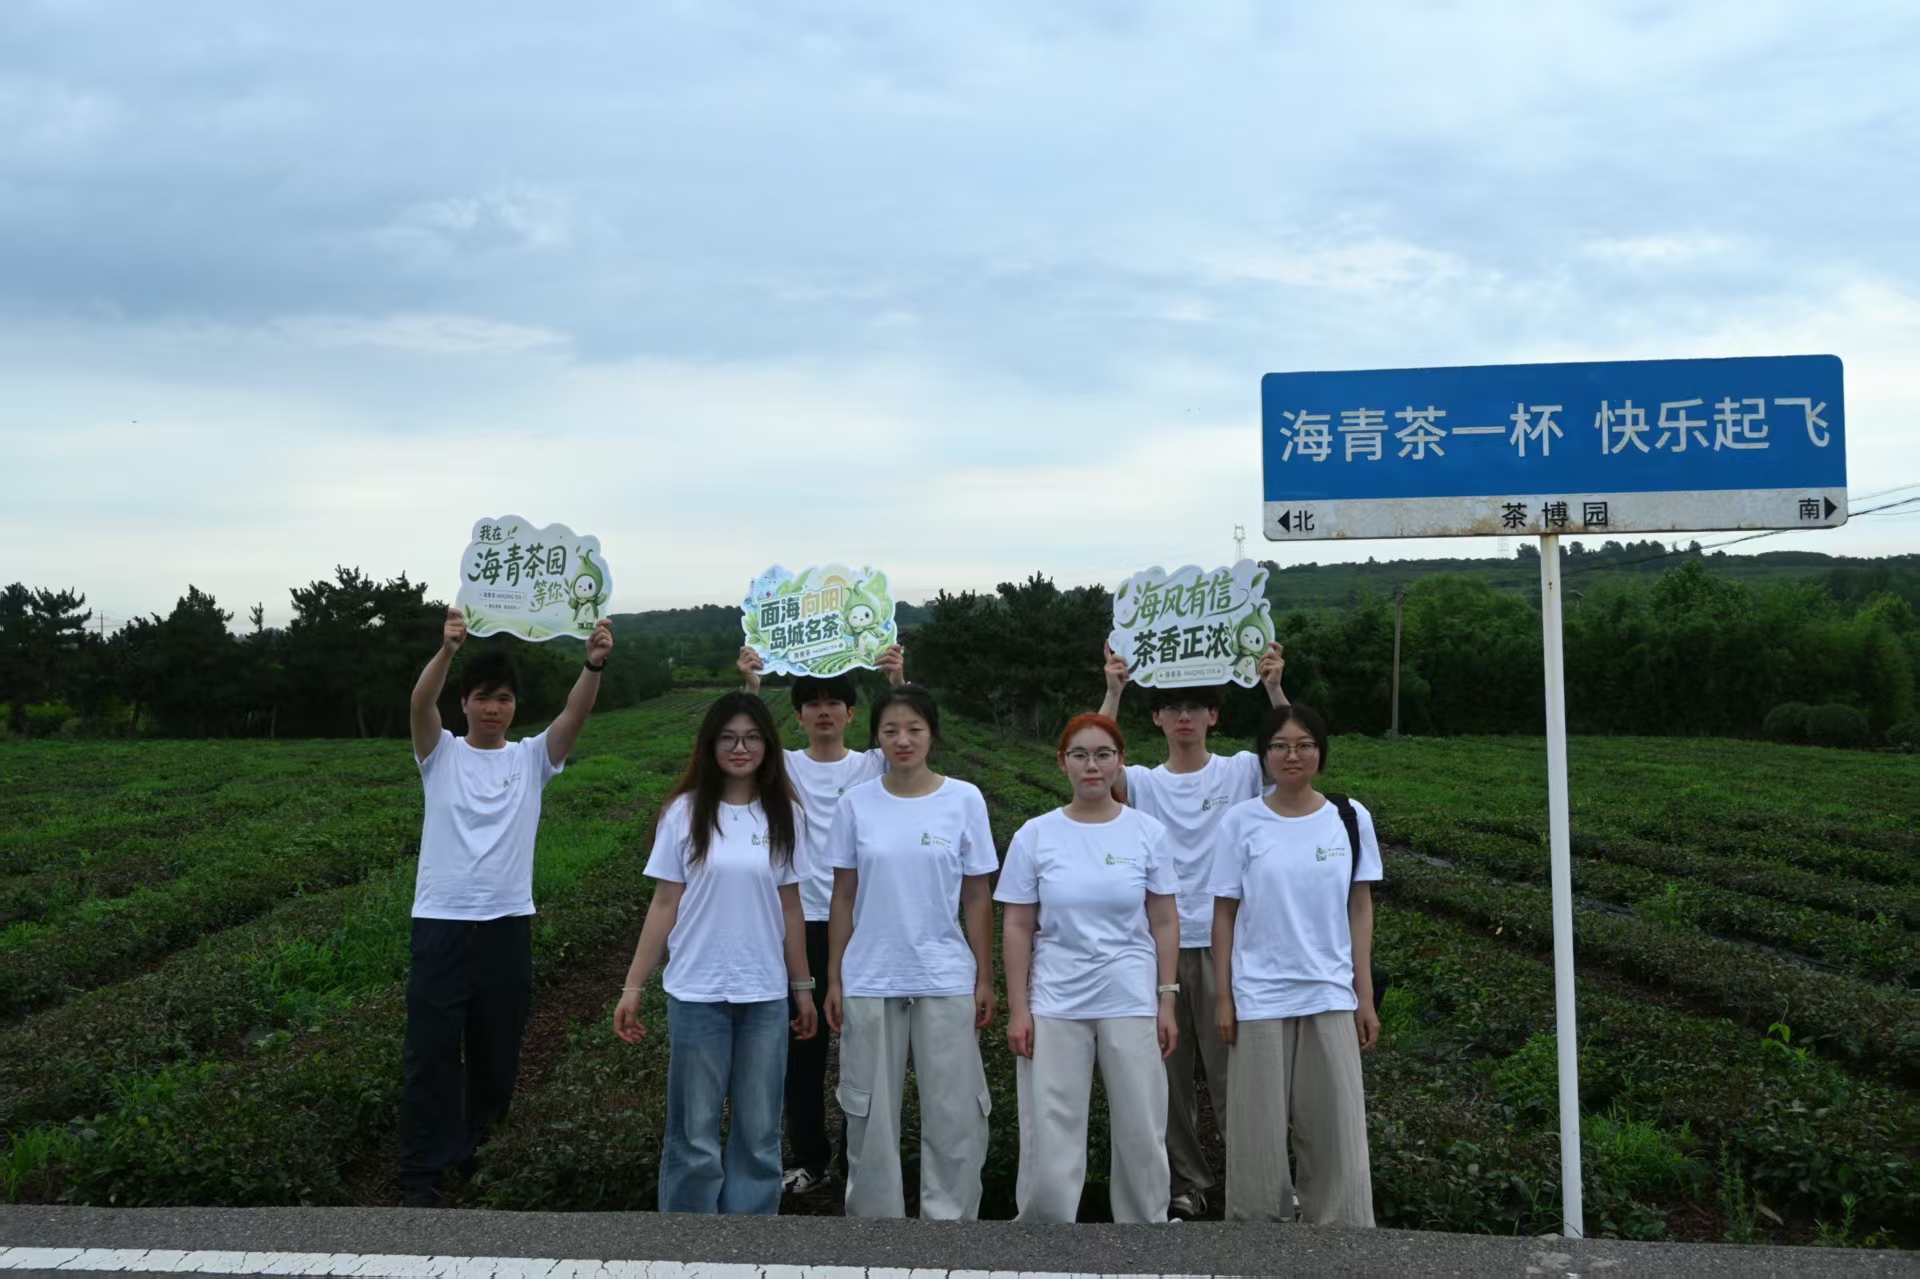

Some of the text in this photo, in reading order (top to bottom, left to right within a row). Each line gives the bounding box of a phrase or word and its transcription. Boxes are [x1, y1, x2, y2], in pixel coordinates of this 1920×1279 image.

[1279, 396, 1831, 463] 海青茶一杯 快乐起飞
[1293, 509, 1315, 532] 北
[1501, 501, 1609, 528] 茶博园
[1798, 498, 1821, 520] 南
[479, 524, 502, 541] 我在
[467, 542, 567, 587] 海青茶园
[528, 579, 565, 612] 等你
[760, 586, 840, 629] 面海向阳
[1118, 569, 1237, 629] 海风有信
[770, 613, 840, 651] 岛城名茶
[1128, 621, 1232, 674] 茶香正浓
